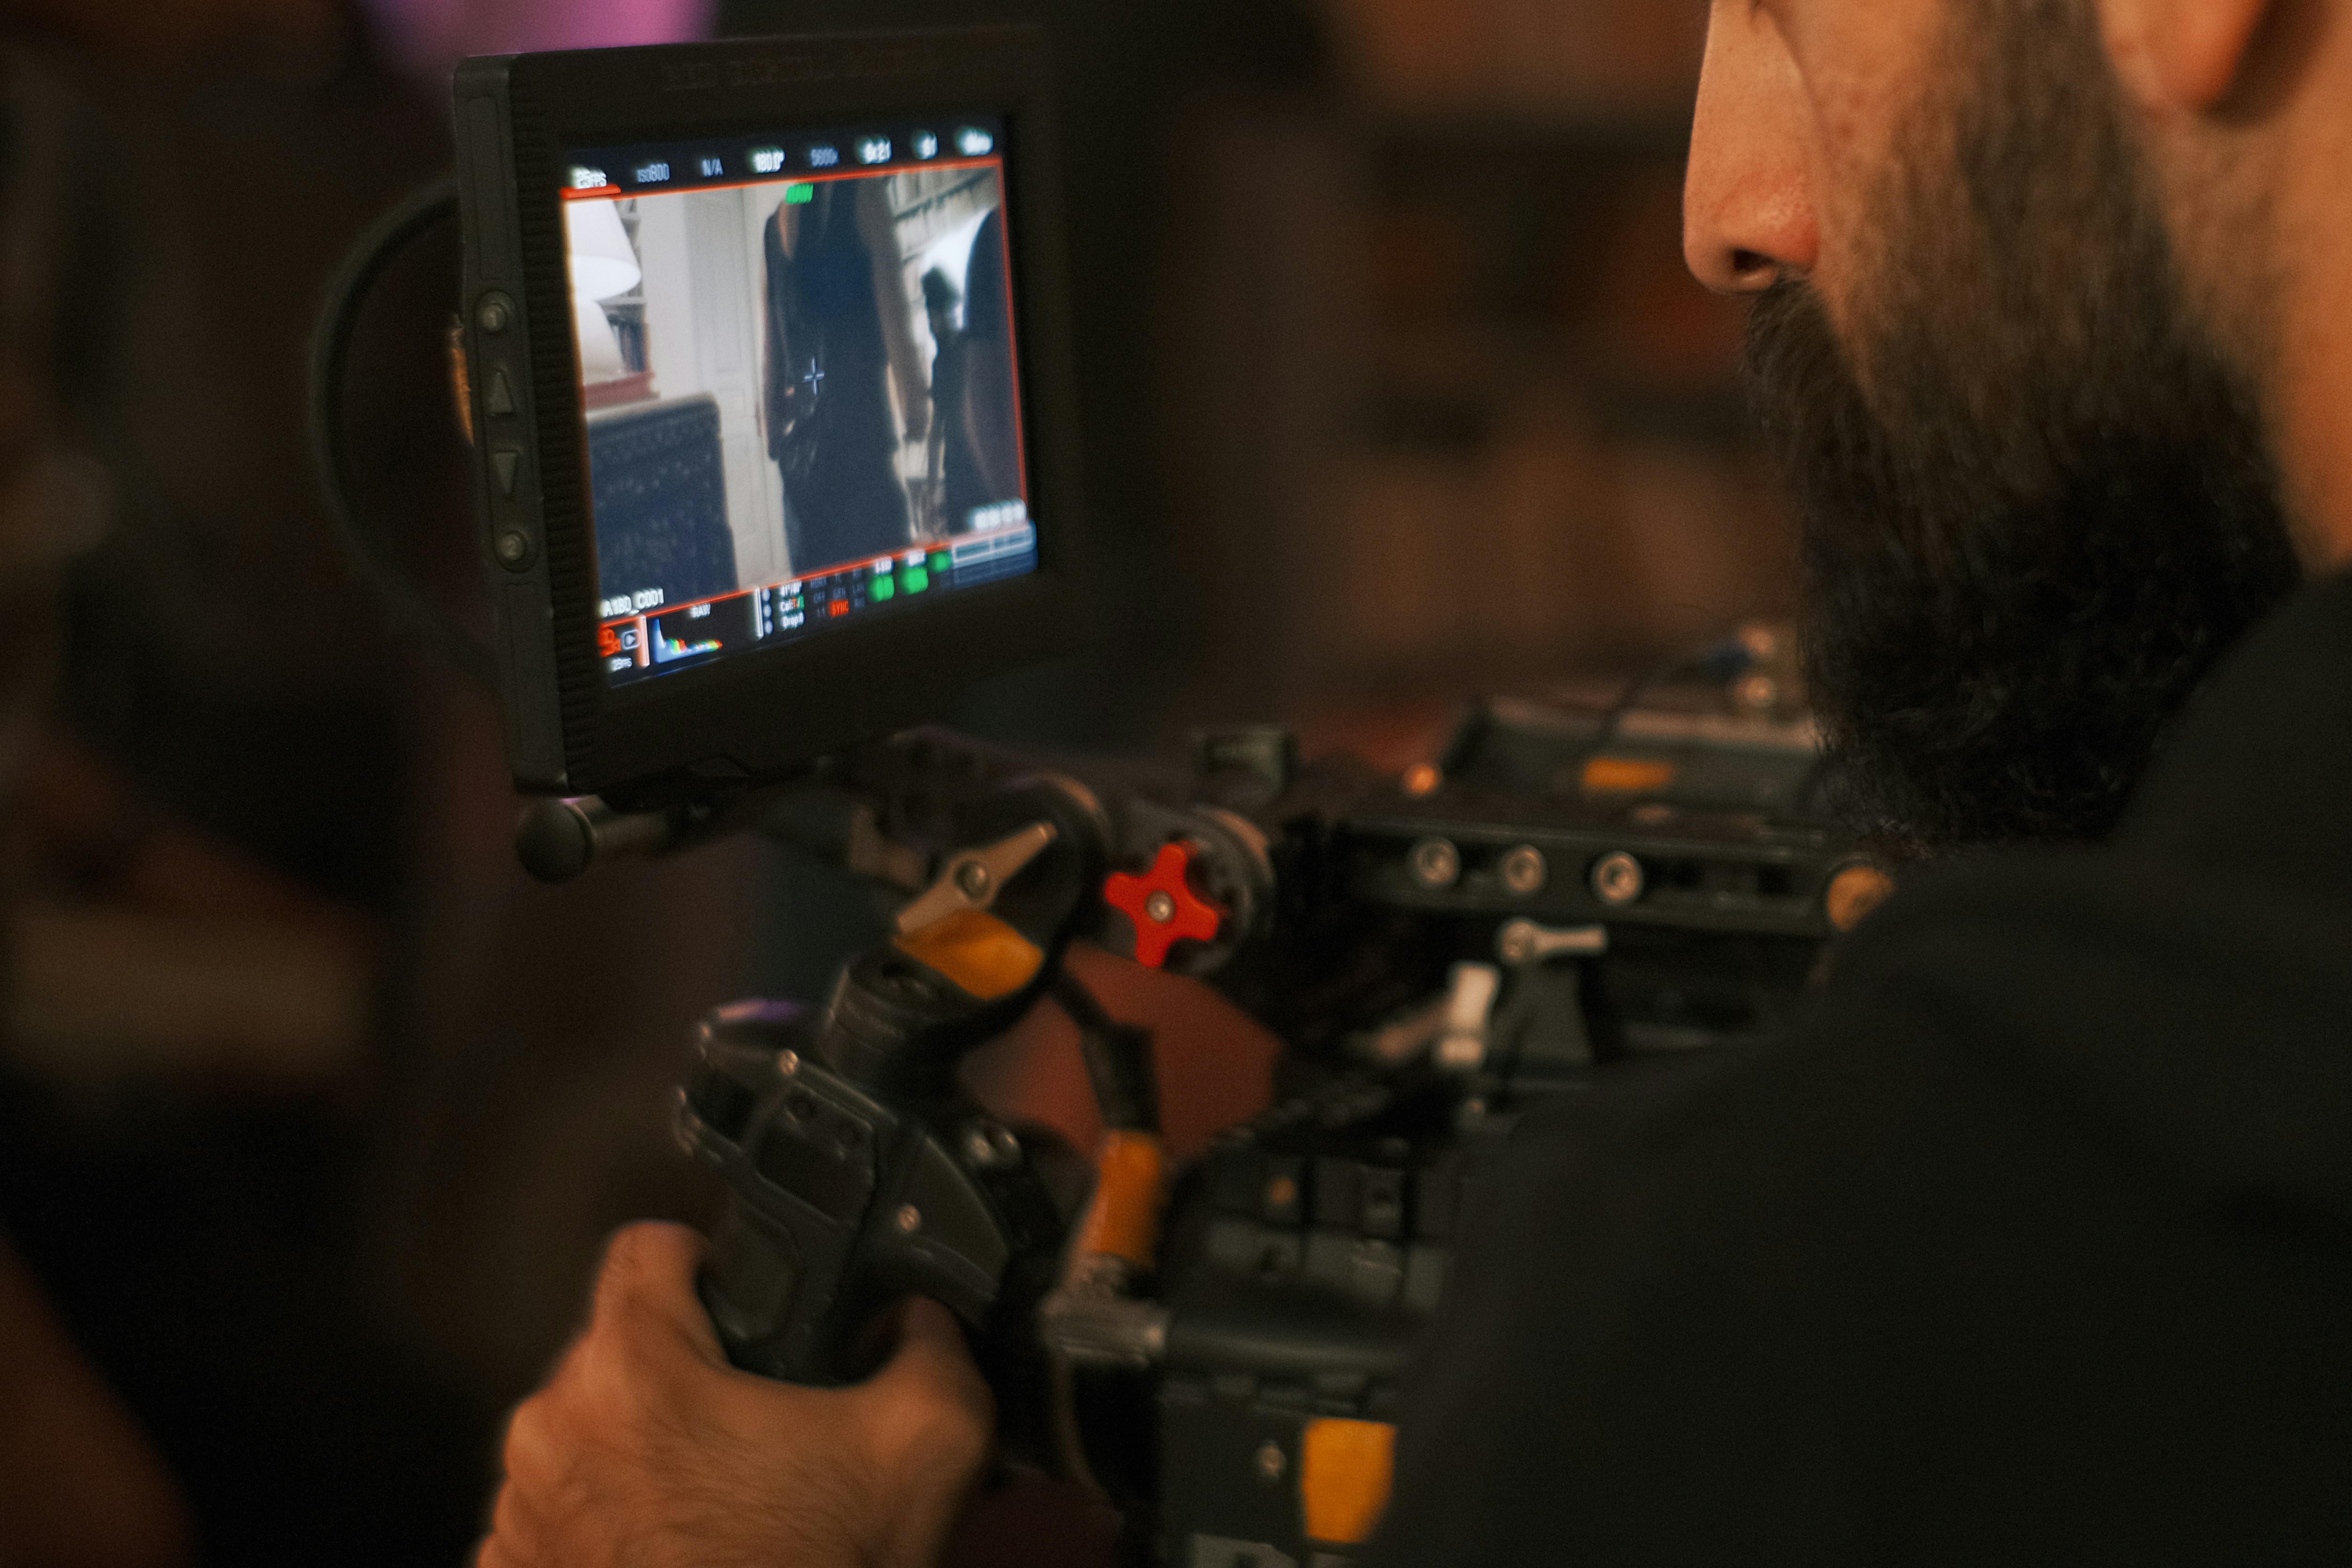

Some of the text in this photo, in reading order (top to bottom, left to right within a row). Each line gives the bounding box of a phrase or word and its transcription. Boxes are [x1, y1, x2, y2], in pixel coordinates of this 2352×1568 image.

[701, 158, 723, 177] N/A
[691, 603, 712, 618] RAW
[830, 600, 849, 617] SYNC
